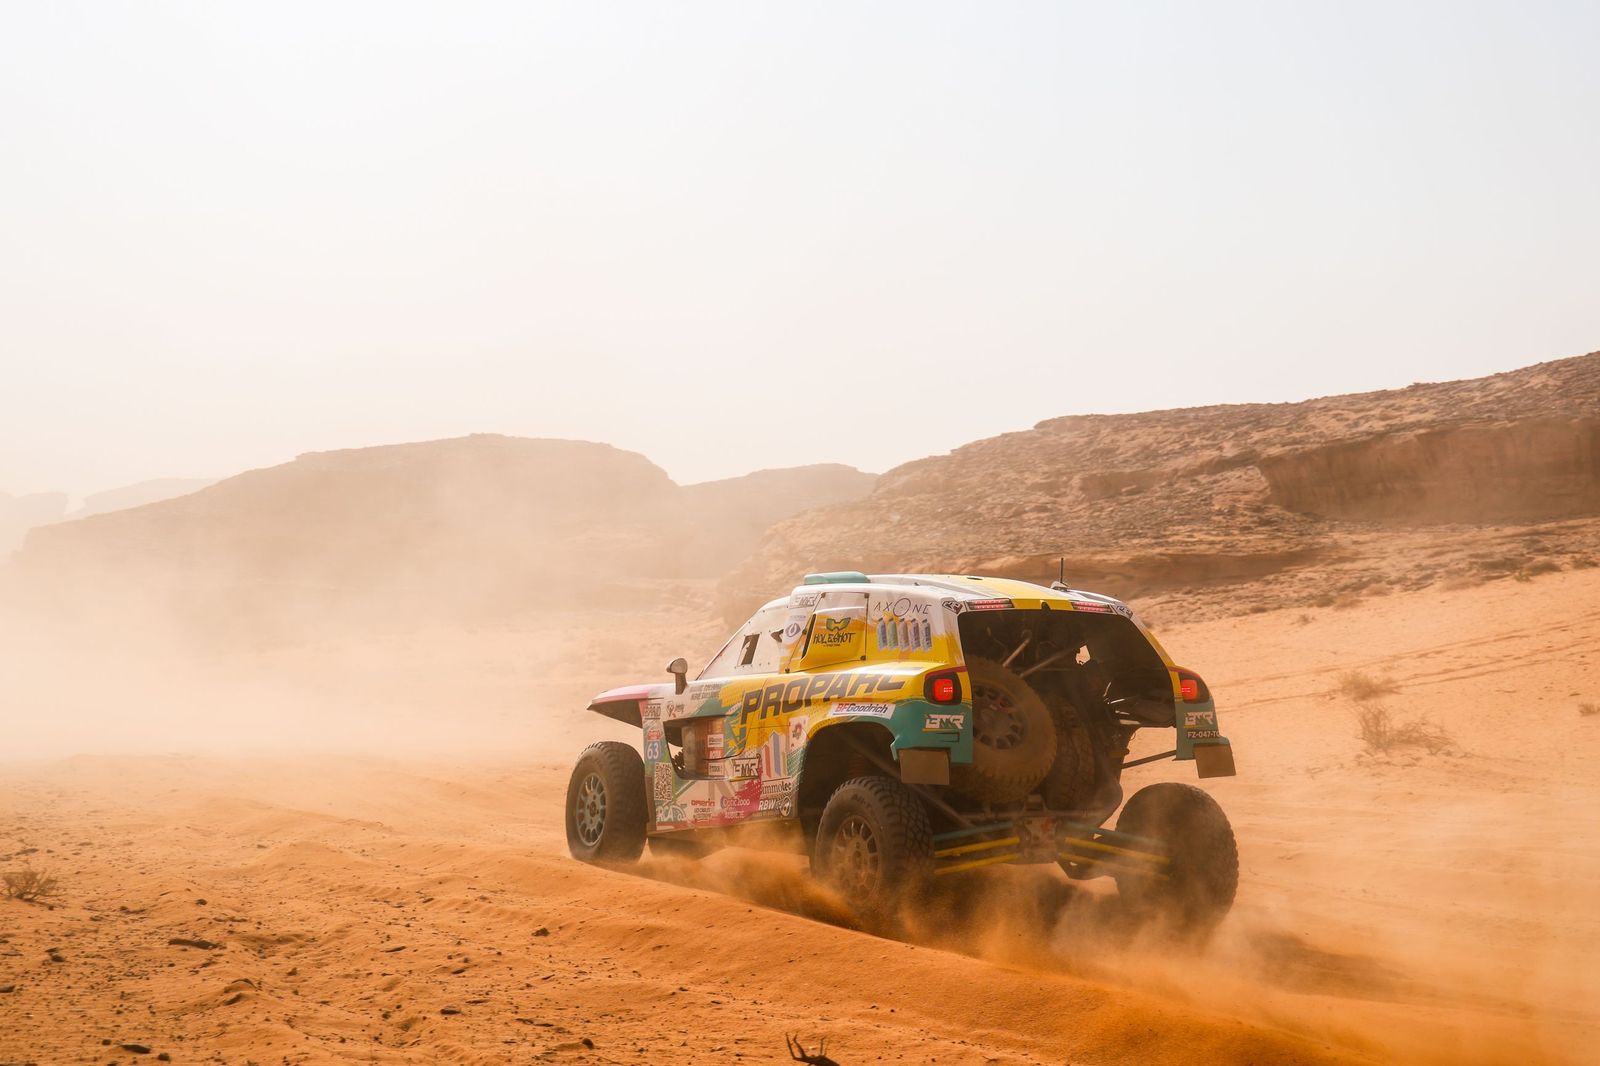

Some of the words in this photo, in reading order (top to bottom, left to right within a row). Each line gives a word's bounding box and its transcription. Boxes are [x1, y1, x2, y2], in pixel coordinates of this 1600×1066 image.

[873, 597, 932, 617] AXONE
[740, 672, 906, 726] PROPARC
[835, 702, 889, 714] BFGoodrich
[647, 741, 660, 760] 63
[758, 799, 776, 811] RBW
